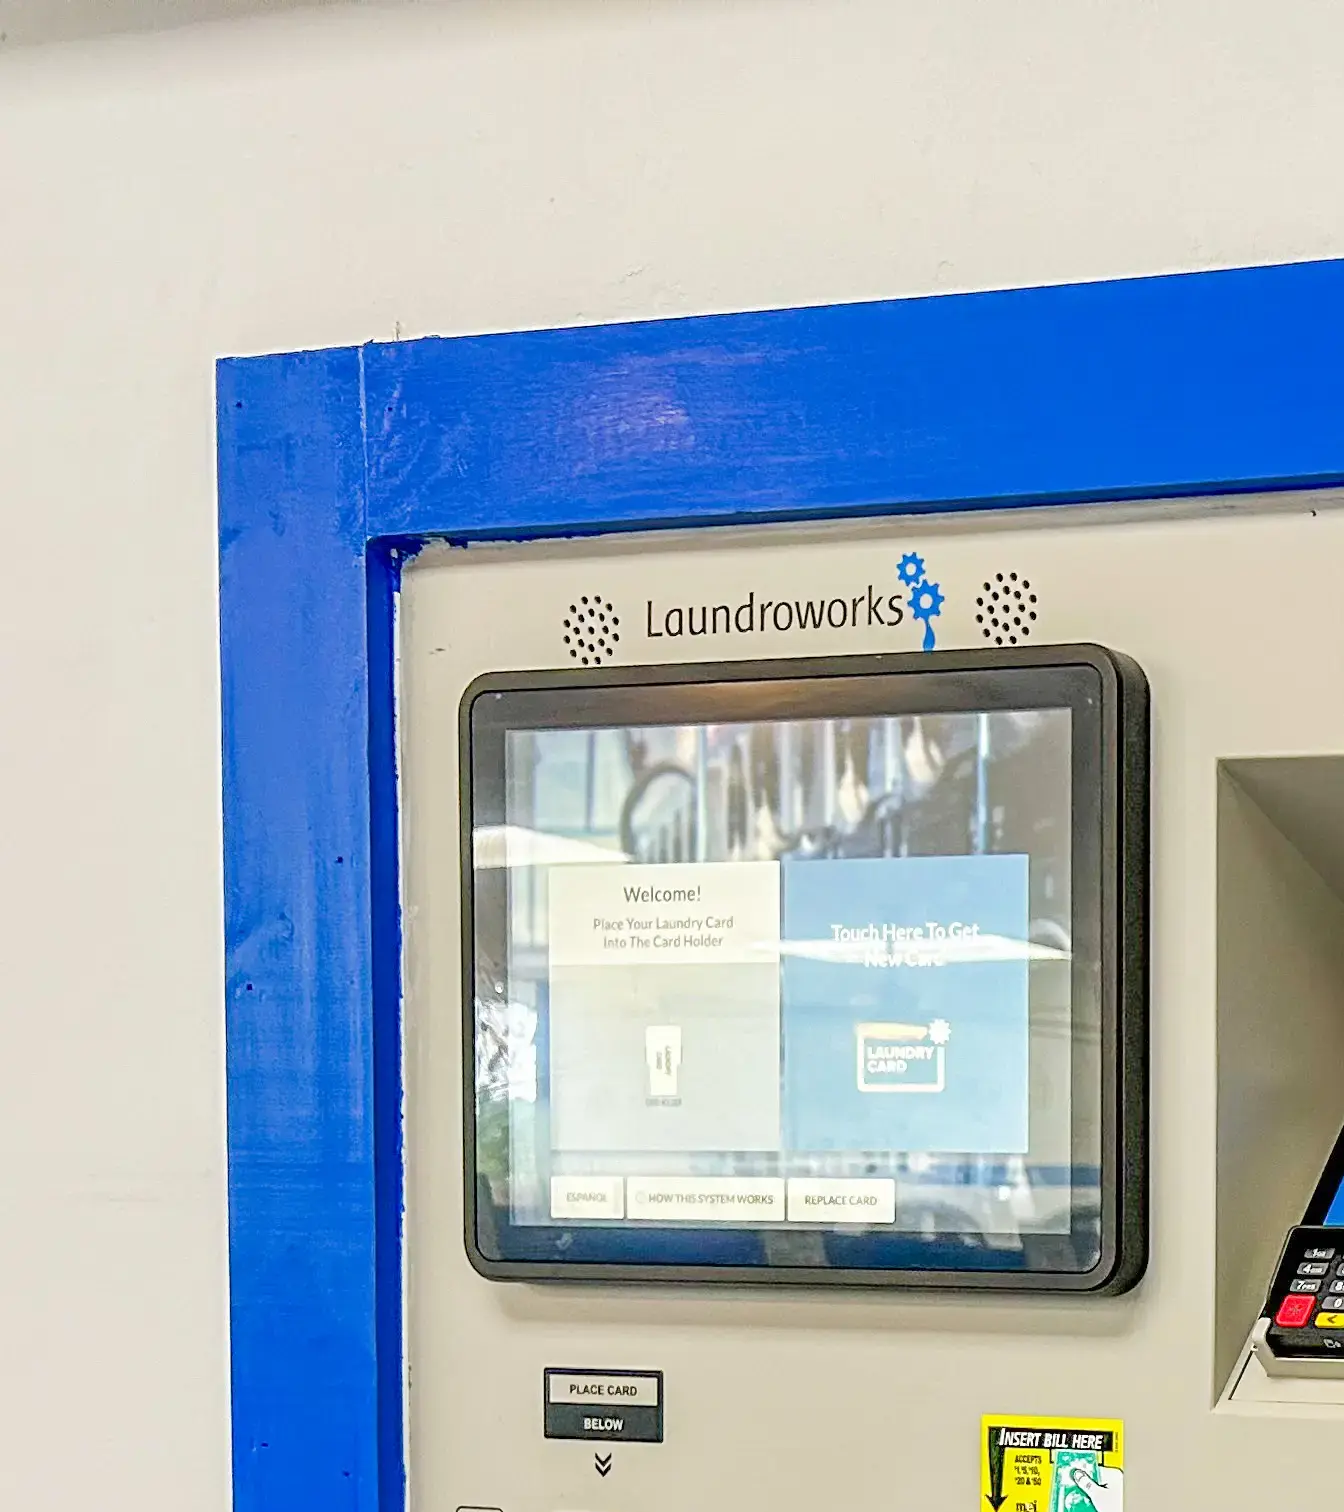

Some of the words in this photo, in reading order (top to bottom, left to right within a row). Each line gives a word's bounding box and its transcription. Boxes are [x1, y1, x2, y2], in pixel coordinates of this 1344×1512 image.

[646, 586, 904, 638] Laundroworks
[623, 886, 701, 903] Welcome!
[593, 919, 624, 931] Place
[626, 918, 652, 930] Your
[656, 917, 702, 931] Laundry
[706, 916, 733, 929] Card
[831, 924, 879, 942] Touch
[883, 924, 923, 941] Here
[926, 923, 945, 940] To
[949, 922, 979, 937] Get
[604, 937, 627, 949] Into
[630, 936, 650, 948] The
[653, 935, 681, 948] Card
[684, 935, 724, 947] Holder
[867, 1046, 935, 1060] LAUNDRY
[867, 1060, 908, 1073] CARD
[649, 1194, 675, 1204] HOW
[676, 1194, 697, 1204] THIS
[698, 1194, 735, 1205] SYSTEM
[737, 1195, 773, 1205] WORKS
[805, 1195, 846, 1205] REPLACE
[849, 1195, 877, 1206] CARD
[569, 1383, 605, 1397] PLACE
[607, 1384, 638, 1397] CARD
[583, 1416, 624, 1432] BELOW
[999, 1428, 1041, 1447] INSERT
[1044, 1433, 1069, 1448] BILL
[1072, 1434, 1103, 1450] HERE
[1014, 1455, 1042, 1464] ACCEPTS
[1016, 1500, 1037, 1512] mei
